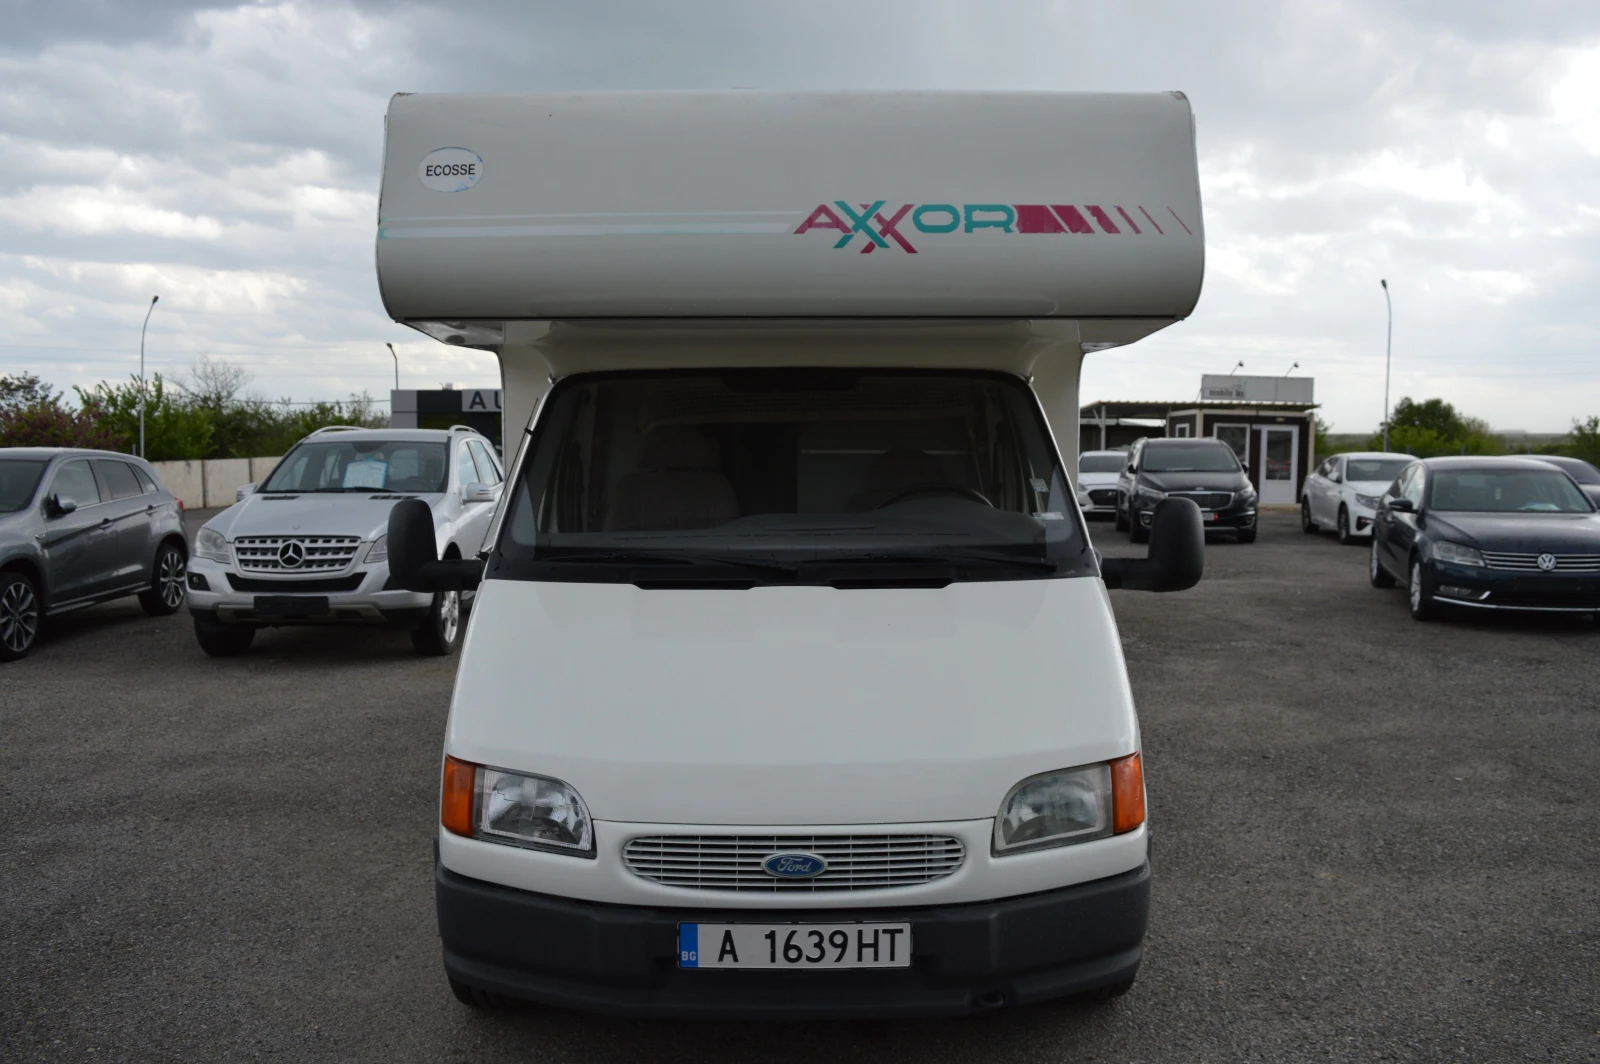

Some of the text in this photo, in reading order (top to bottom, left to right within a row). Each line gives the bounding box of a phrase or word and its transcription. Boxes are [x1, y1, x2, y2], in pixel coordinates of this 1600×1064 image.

[426, 164, 476, 177] ECOSSE
[793, 200, 1015, 254] AXXOR
[777, 857, 812, 873] Ford
[681, 951, 697, 961] BG
